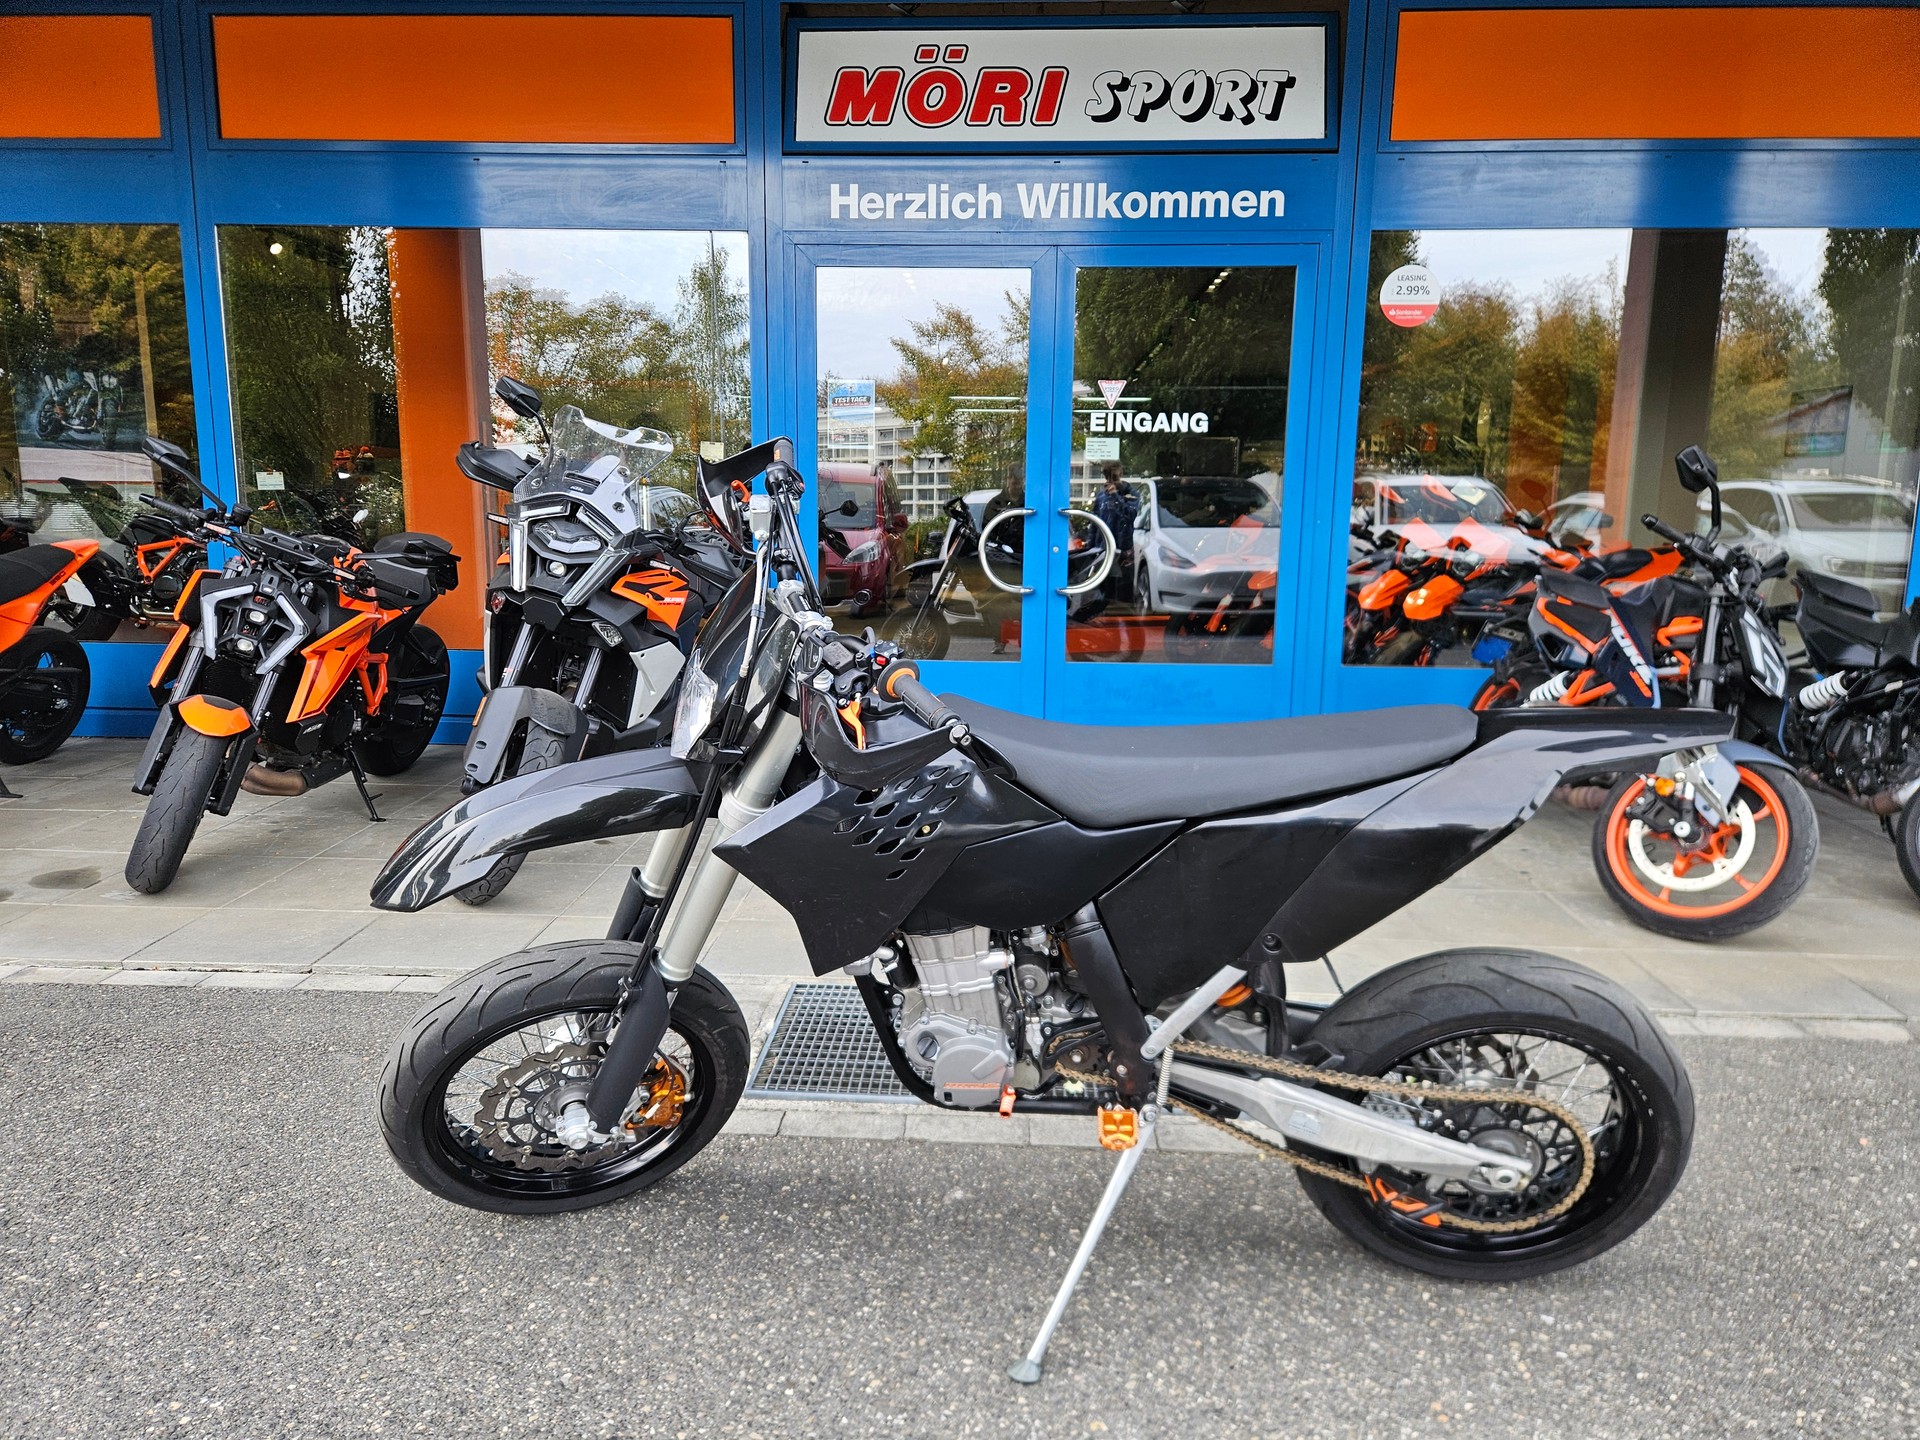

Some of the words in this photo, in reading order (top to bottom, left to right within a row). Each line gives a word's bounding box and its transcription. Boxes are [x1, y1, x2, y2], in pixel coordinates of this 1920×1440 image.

[824, 44, 1069, 127] MÖRI
[1084, 69, 1297, 125] SPORT
[830, 183, 1002, 220] Herzlich
[1017, 182, 1286, 219] Willkommen
[1396, 285, 1430, 295] 2.99%
[1090, 411, 1209, 433] EINGANG
